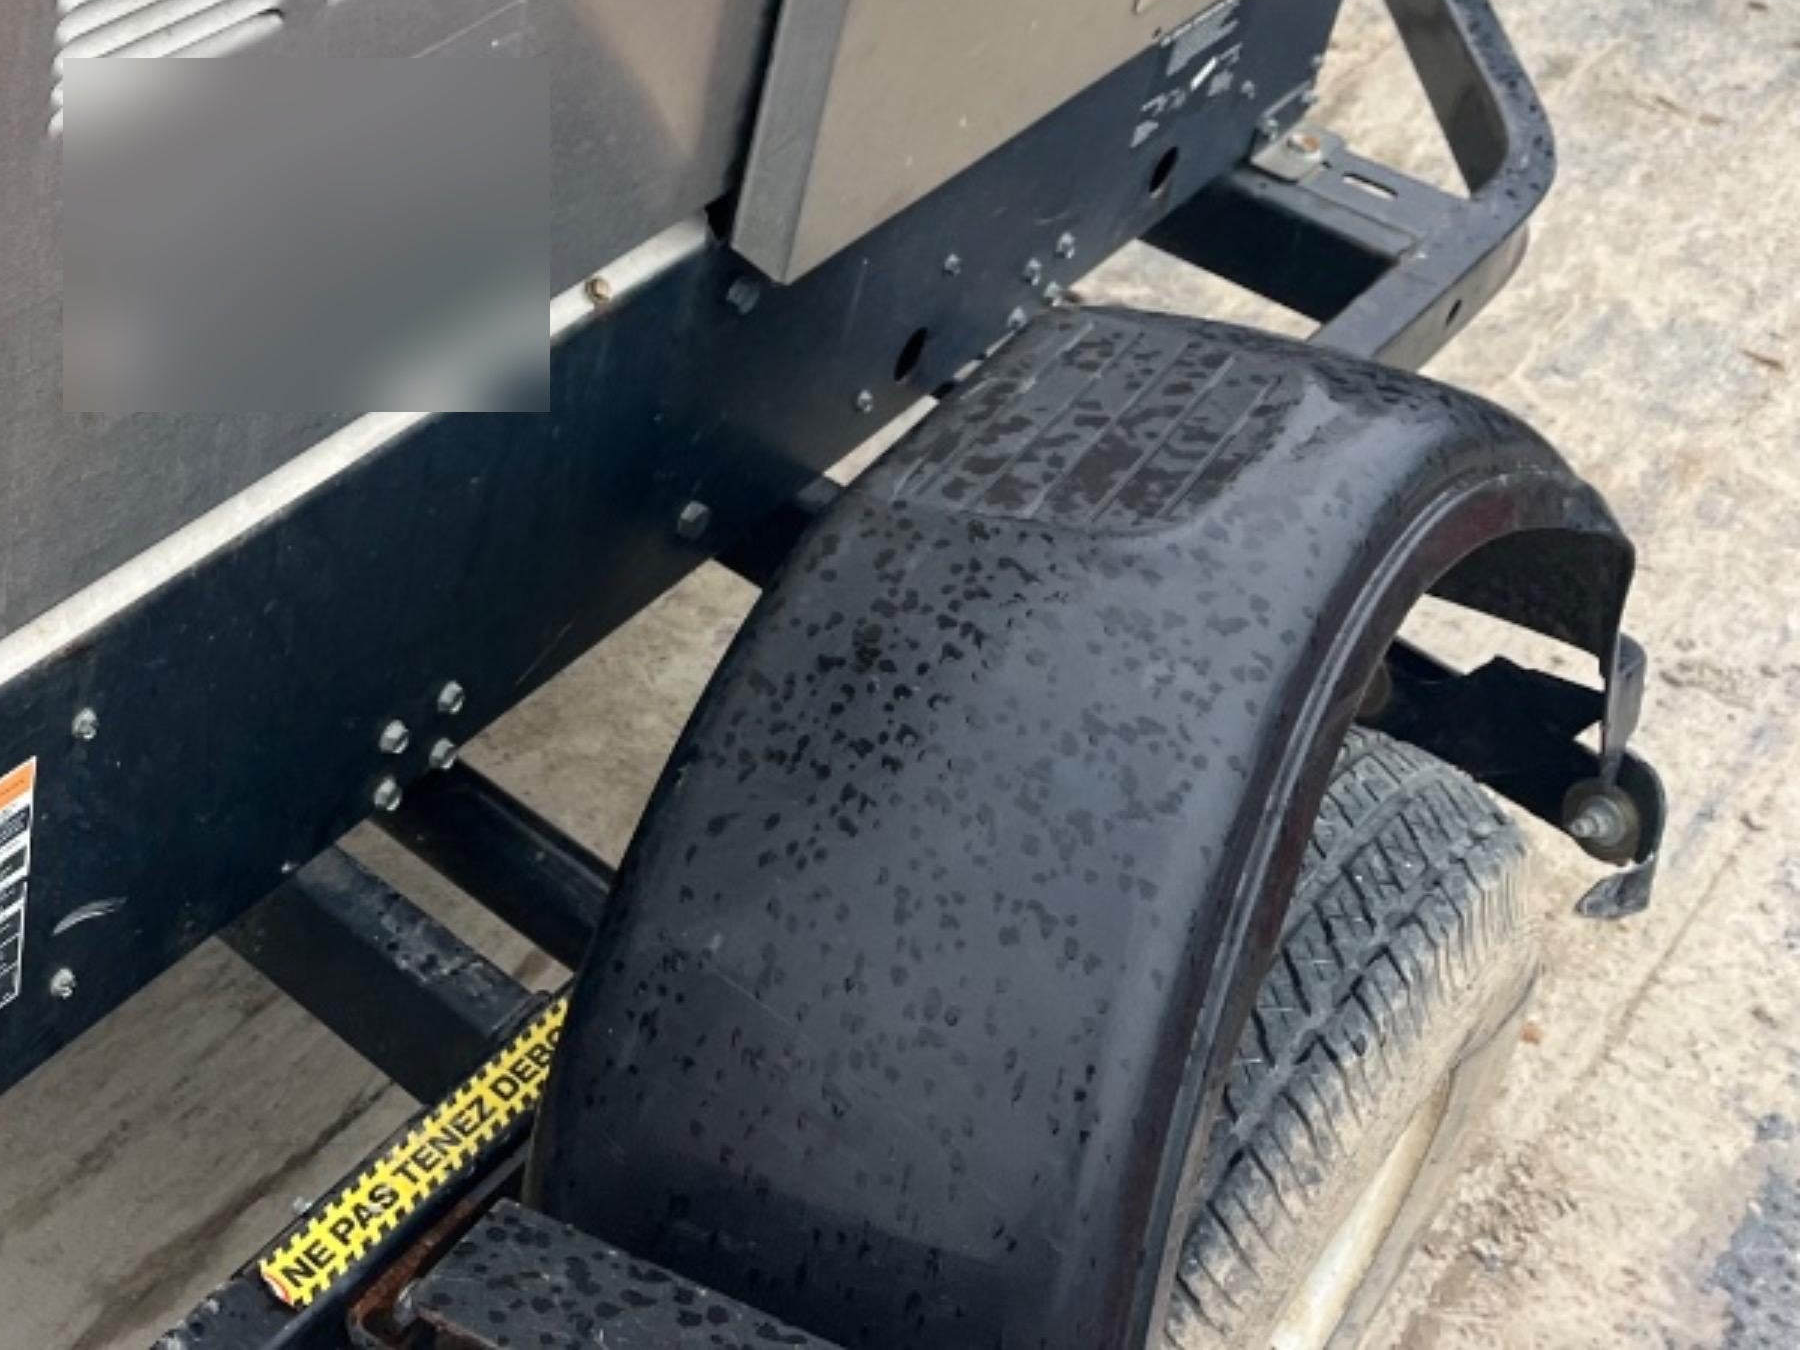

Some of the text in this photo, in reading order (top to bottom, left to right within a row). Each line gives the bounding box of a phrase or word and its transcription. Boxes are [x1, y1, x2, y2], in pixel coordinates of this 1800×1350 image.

[281, 1241, 337, 1288] NE
[329, 1183, 401, 1245] PAS
[393, 1097, 496, 1186] TENEZ
